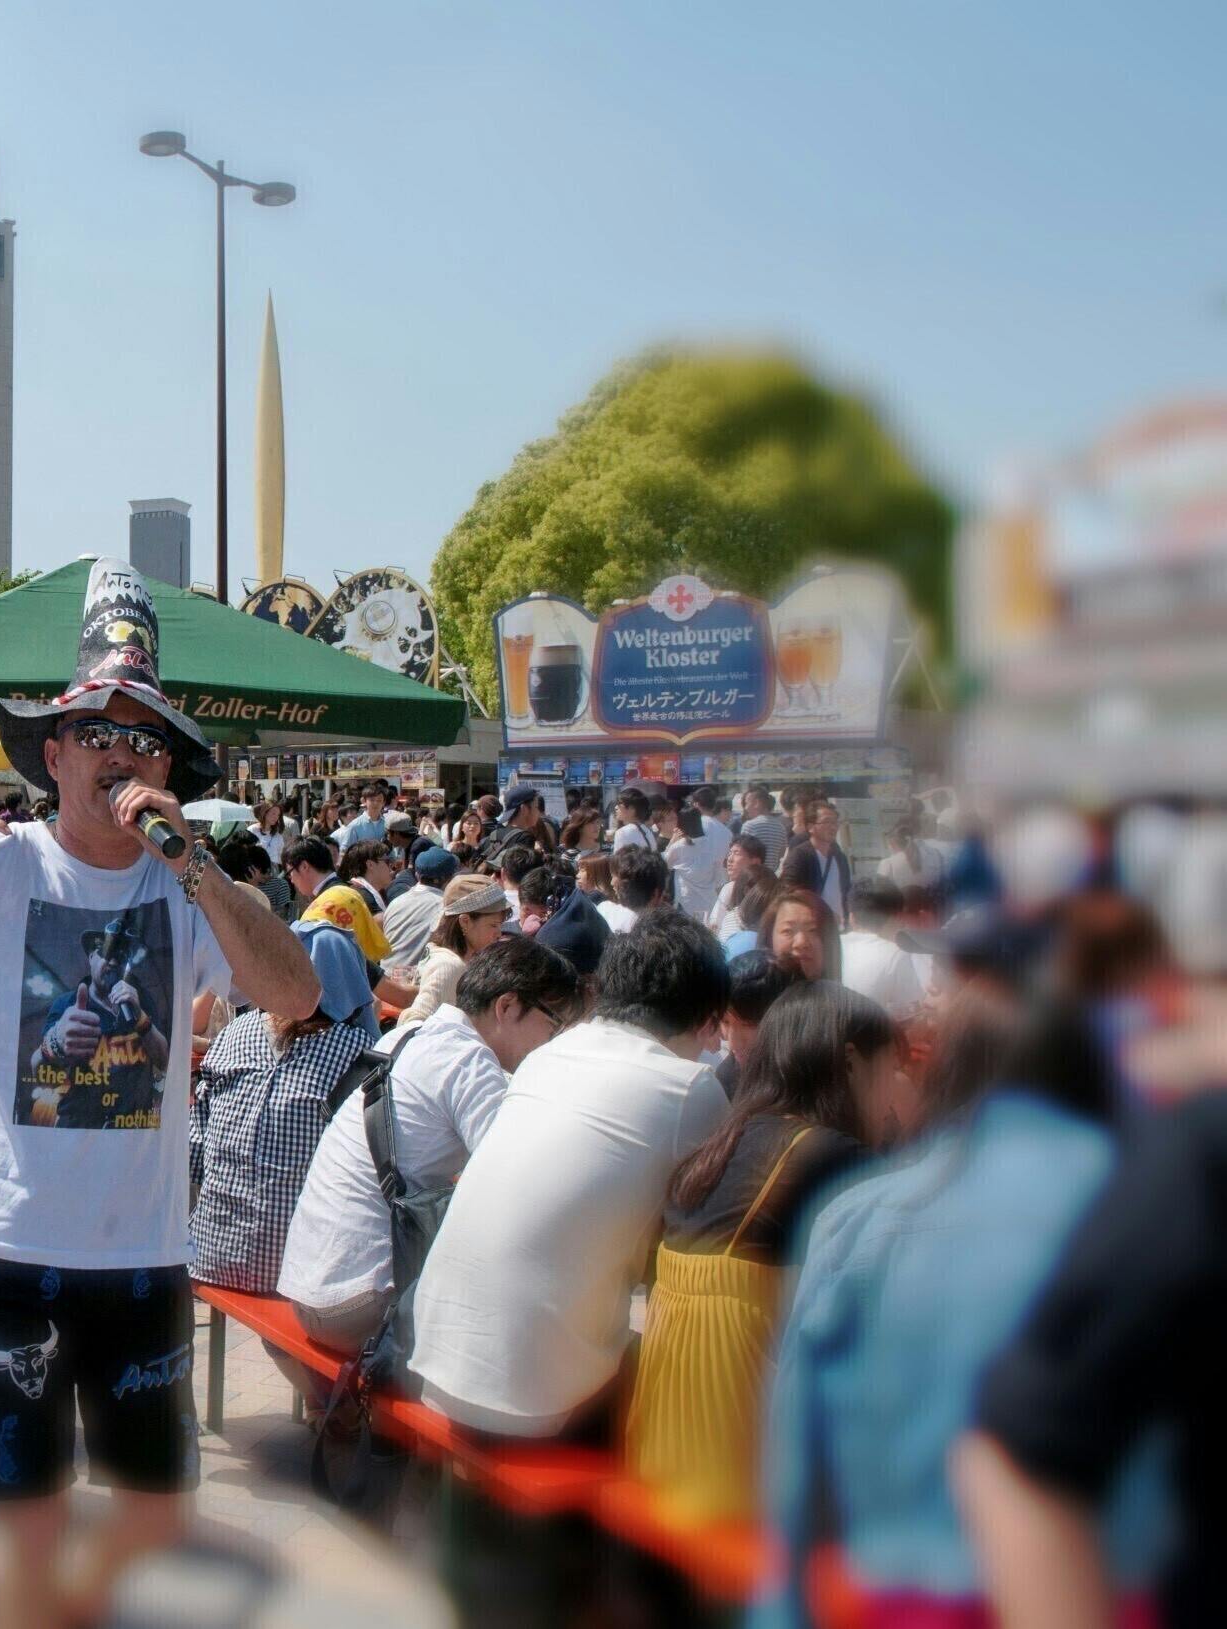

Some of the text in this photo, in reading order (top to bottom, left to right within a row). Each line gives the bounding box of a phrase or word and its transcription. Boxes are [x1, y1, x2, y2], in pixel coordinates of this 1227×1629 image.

[613, 625, 753, 648] Weltenburger
[645, 648, 720, 668] Kloster
[612, 688, 755, 710] ヴェルテンブルガー
[194, 695, 329, 725] Zoller-Hof
[75, 1066, 111, 1086] best
[102, 1093, 119, 1107] or
